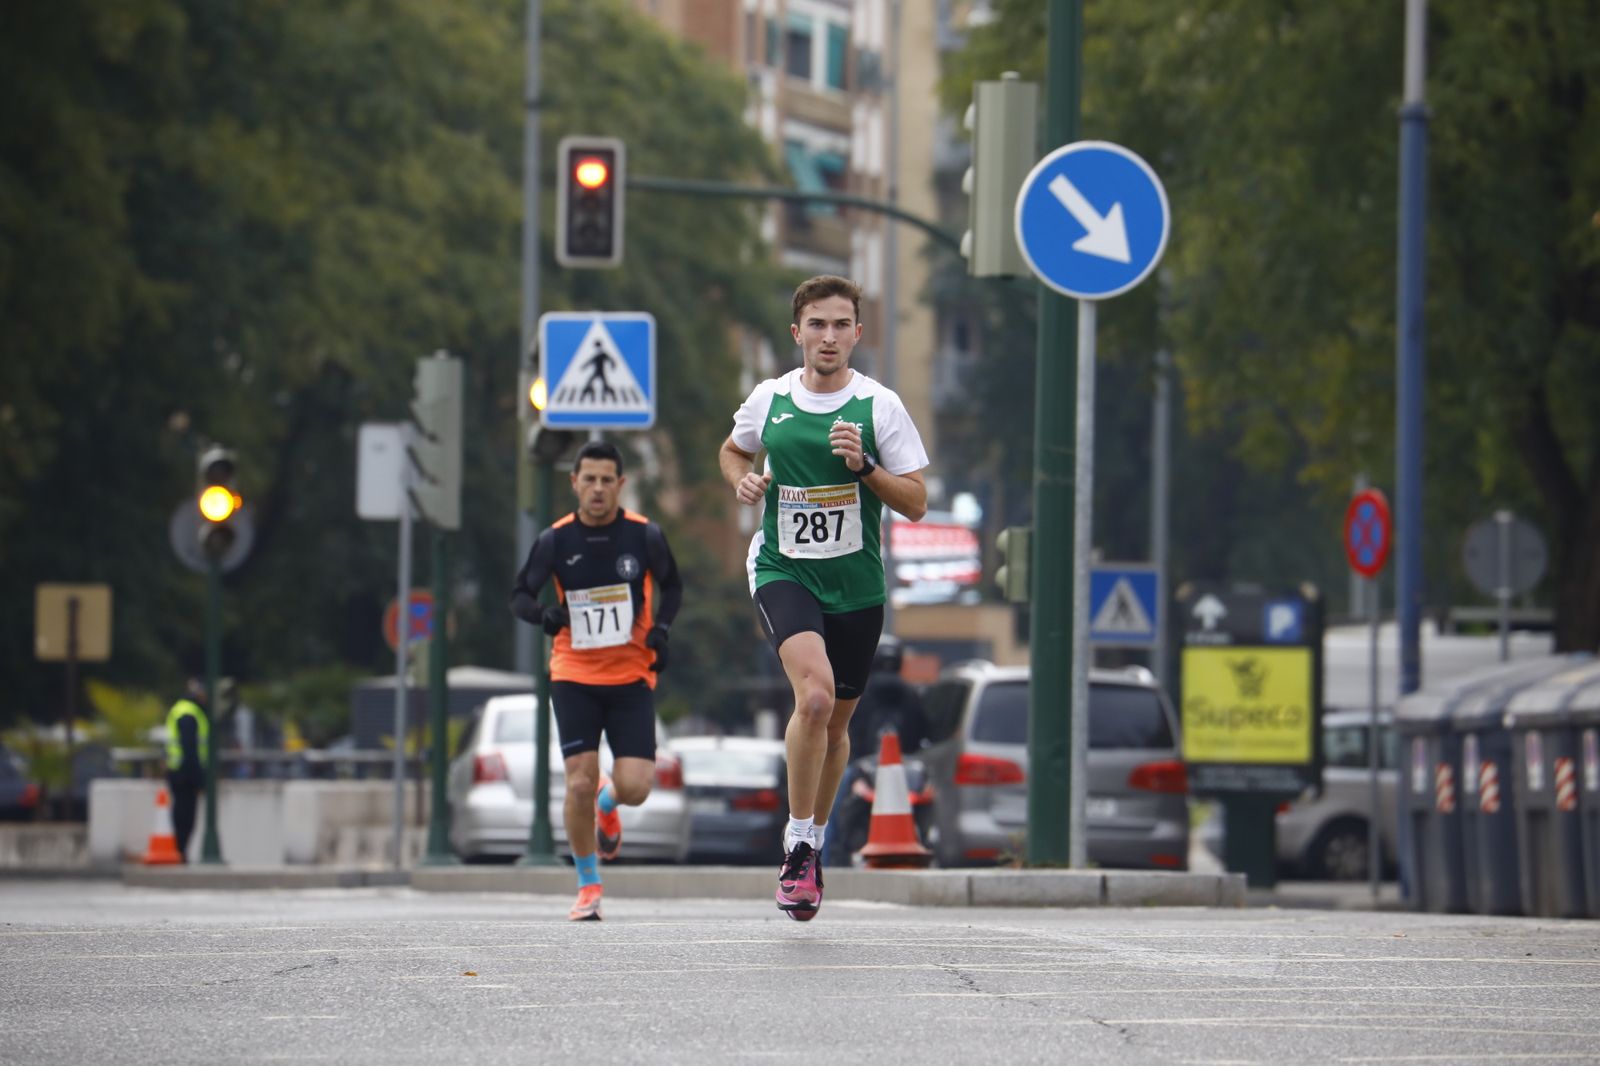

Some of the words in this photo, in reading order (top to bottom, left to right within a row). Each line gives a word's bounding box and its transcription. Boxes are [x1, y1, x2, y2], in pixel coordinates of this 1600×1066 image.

[781, 488, 807, 502] XXXIX
[793, 510, 844, 544] 287
[582, 606, 620, 636] 171
[1269, 604, 1295, 639] P
